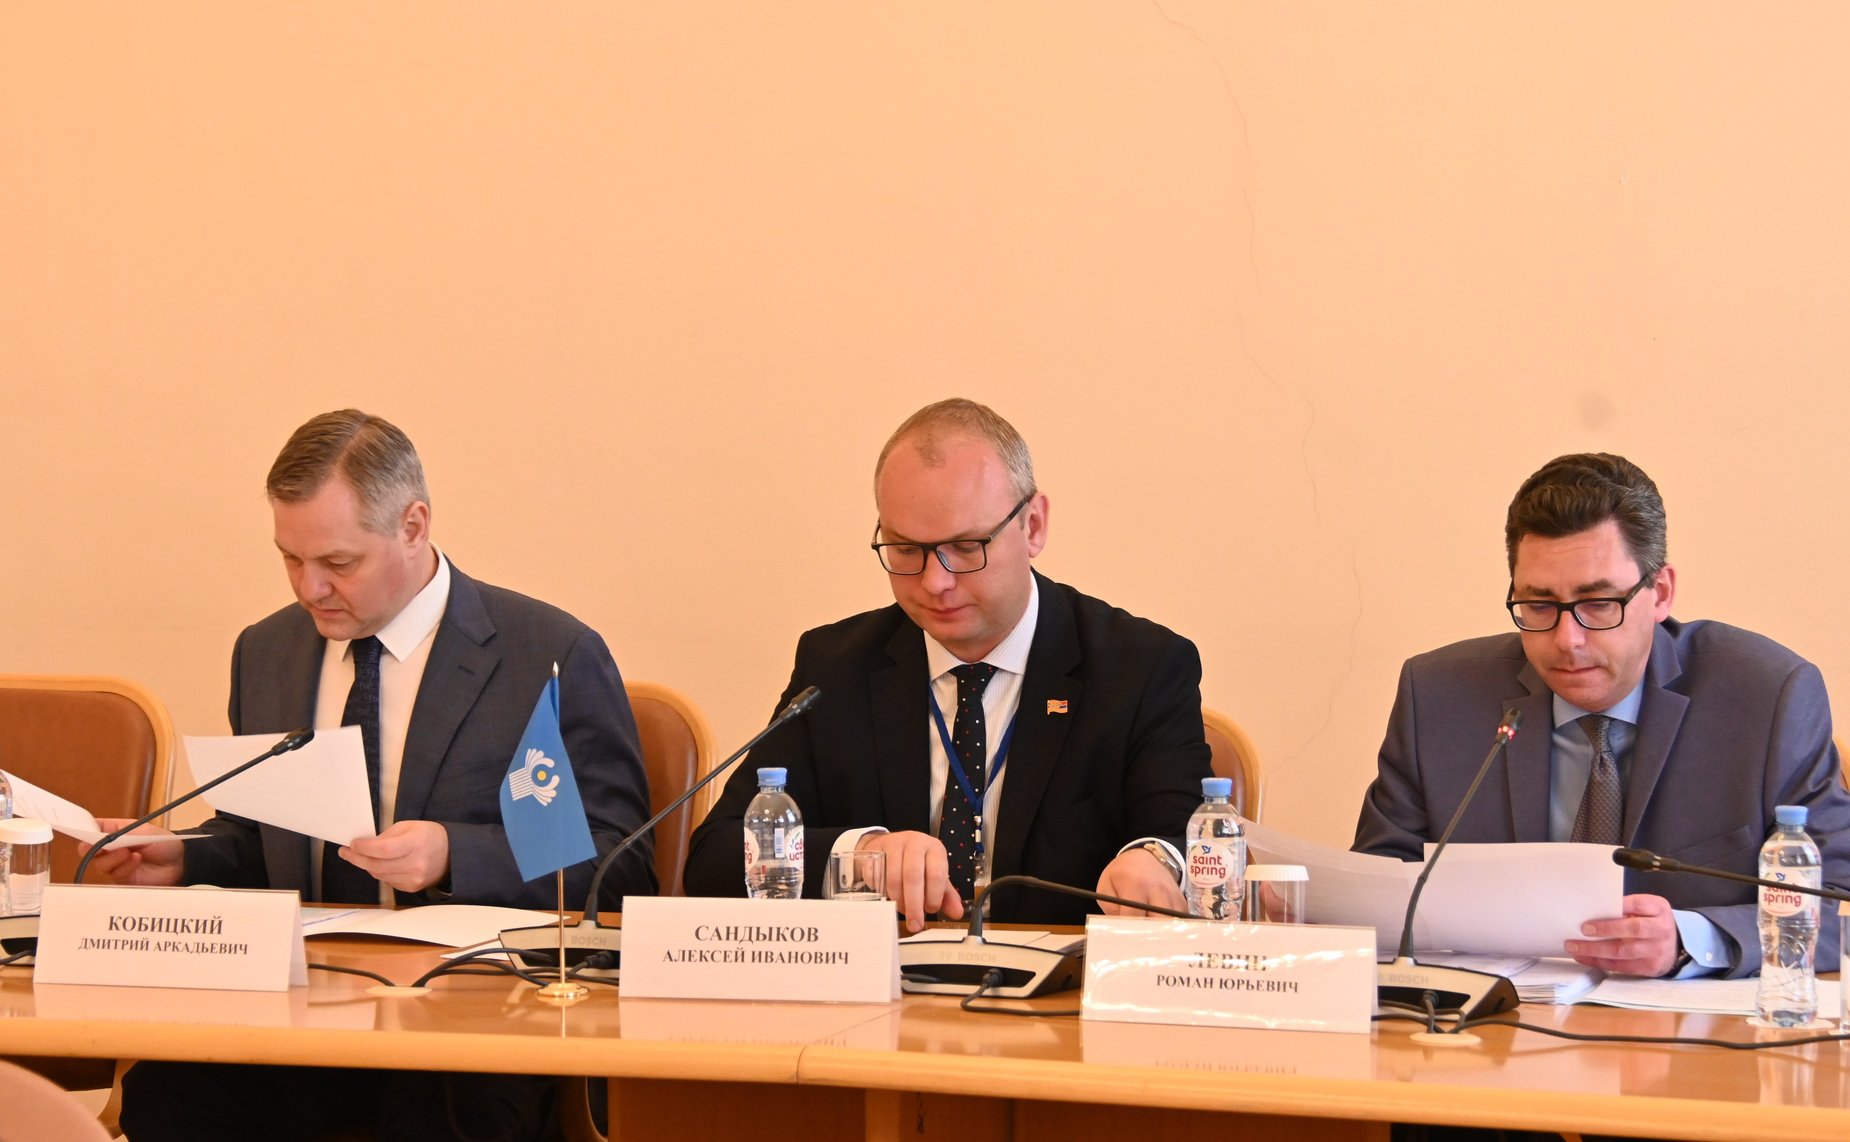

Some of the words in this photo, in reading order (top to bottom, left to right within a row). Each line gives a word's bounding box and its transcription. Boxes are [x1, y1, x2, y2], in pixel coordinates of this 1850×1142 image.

[1192, 855, 1222, 865] saint
[1190, 865, 1226, 879] spring
[1763, 893, 1801, 907] spring
[108, 915, 223, 935] КОБИЦКИЙ
[571, 936, 607, 946] BOSCH
[694, 925, 819, 945] САНДЫКОВ
[78, 937, 150, 951] ДМИТРИЙ
[152, 940, 249, 955] АРКАДЬЕВИЧ
[662, 947, 746, 963] АЛЕКСЕЙ
[750, 950, 849, 965] ИВАНОВИЧ
[1156, 974, 1214, 990] РОМАН
[1219, 977, 1299, 994] ЮРЬЕВИЧ
[1389, 973, 1430, 985] BOSCH
